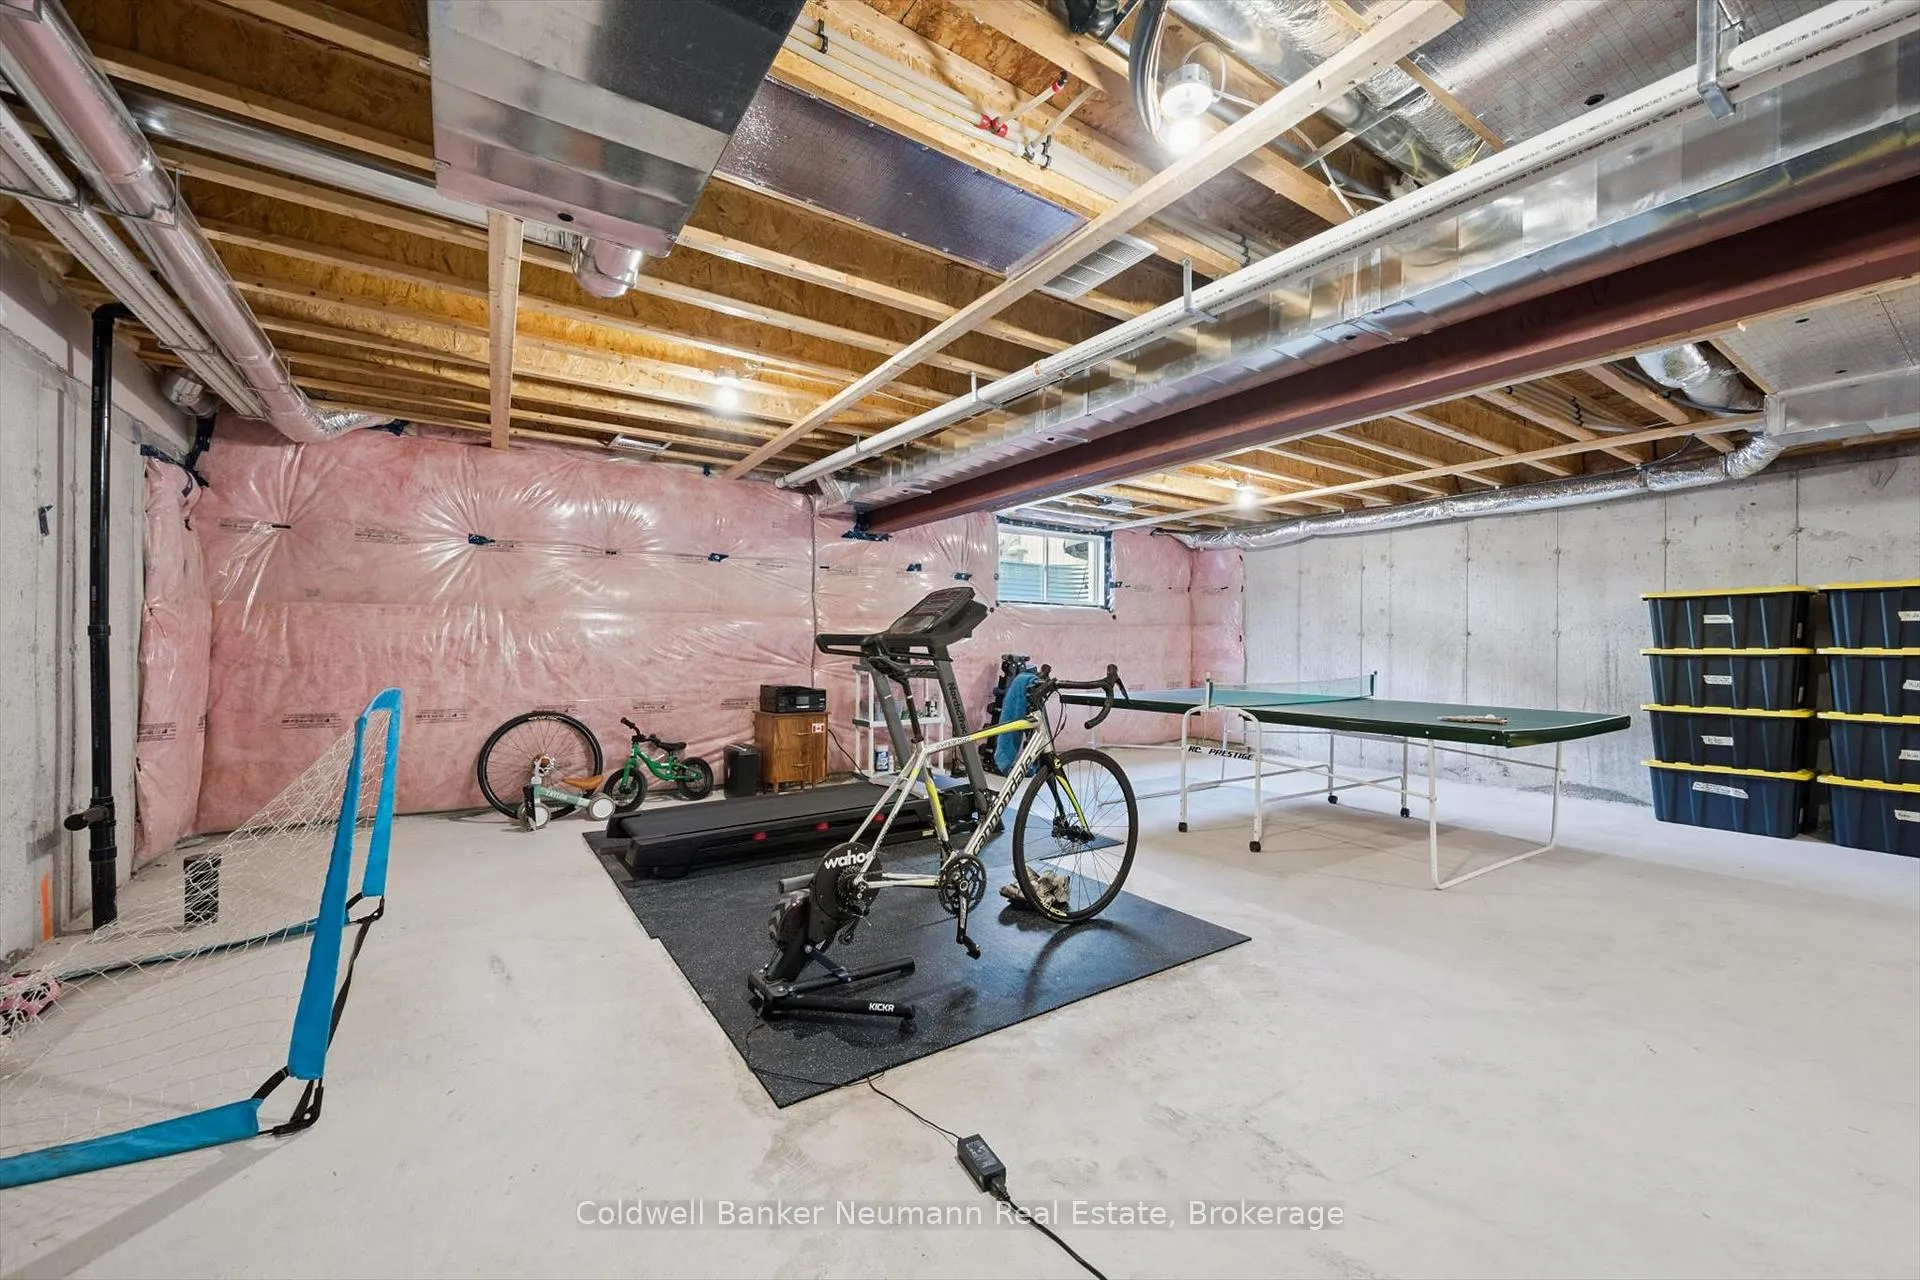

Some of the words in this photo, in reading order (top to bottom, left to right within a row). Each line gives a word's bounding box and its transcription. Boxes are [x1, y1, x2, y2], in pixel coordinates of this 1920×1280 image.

[947, 681, 968, 736] NordicTrac
[1208, 748, 1255, 761] PRESTIGE
[972, 755, 1033, 857] cannondale
[868, 1002, 895, 1013] KICKR
